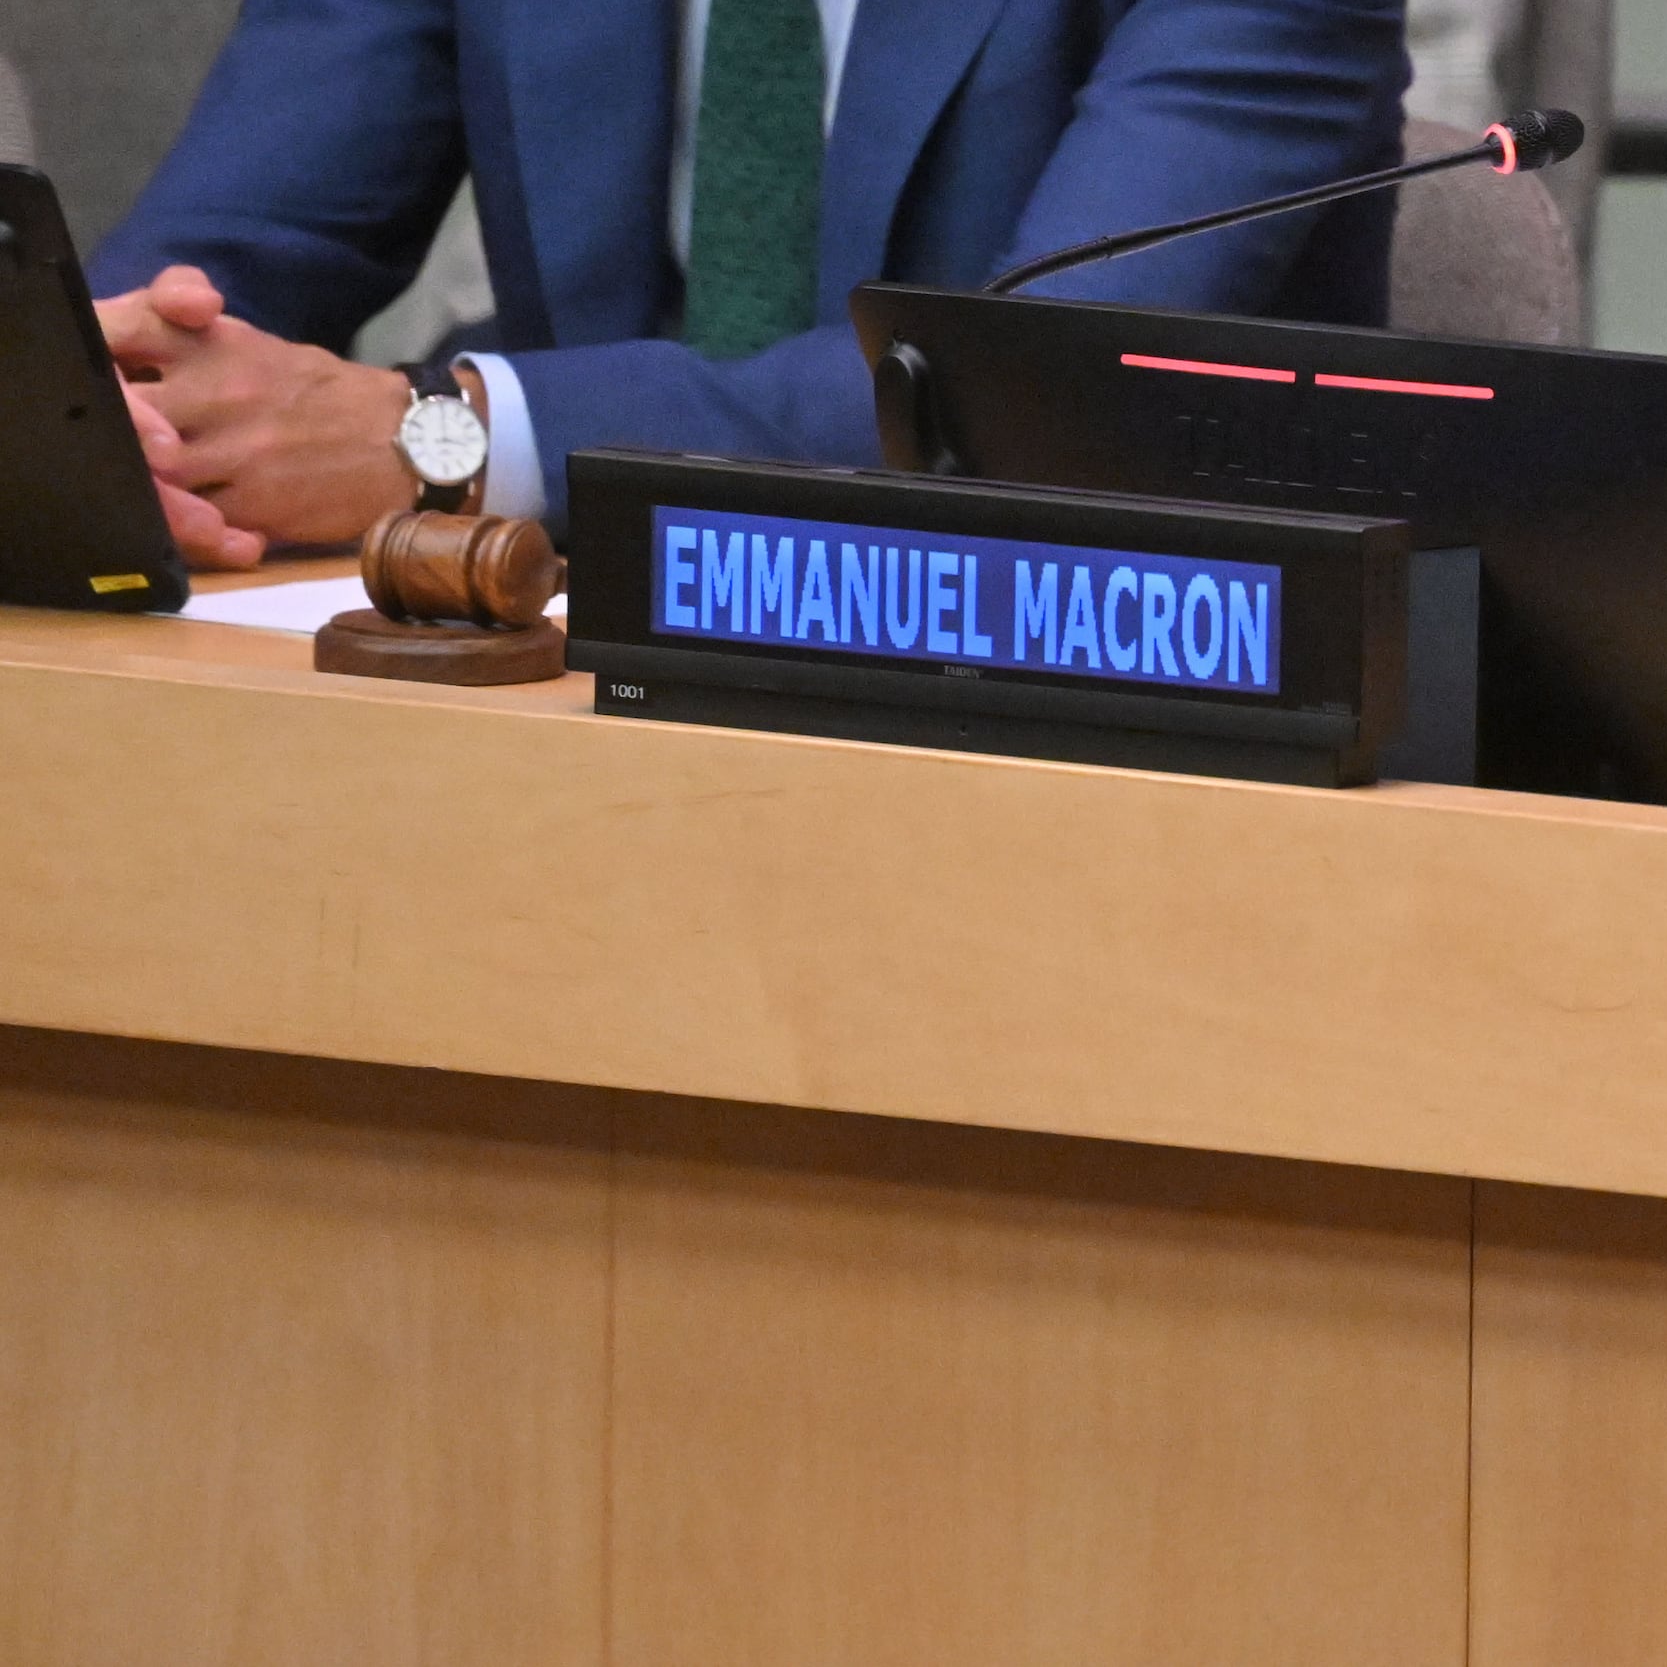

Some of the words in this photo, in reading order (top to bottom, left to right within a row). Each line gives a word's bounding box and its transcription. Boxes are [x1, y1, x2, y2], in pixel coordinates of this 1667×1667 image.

[664, 525, 992, 658] EMMANUEL
[1013, 559, 1269, 685] MACRON
[609, 683, 646, 700] 1001
